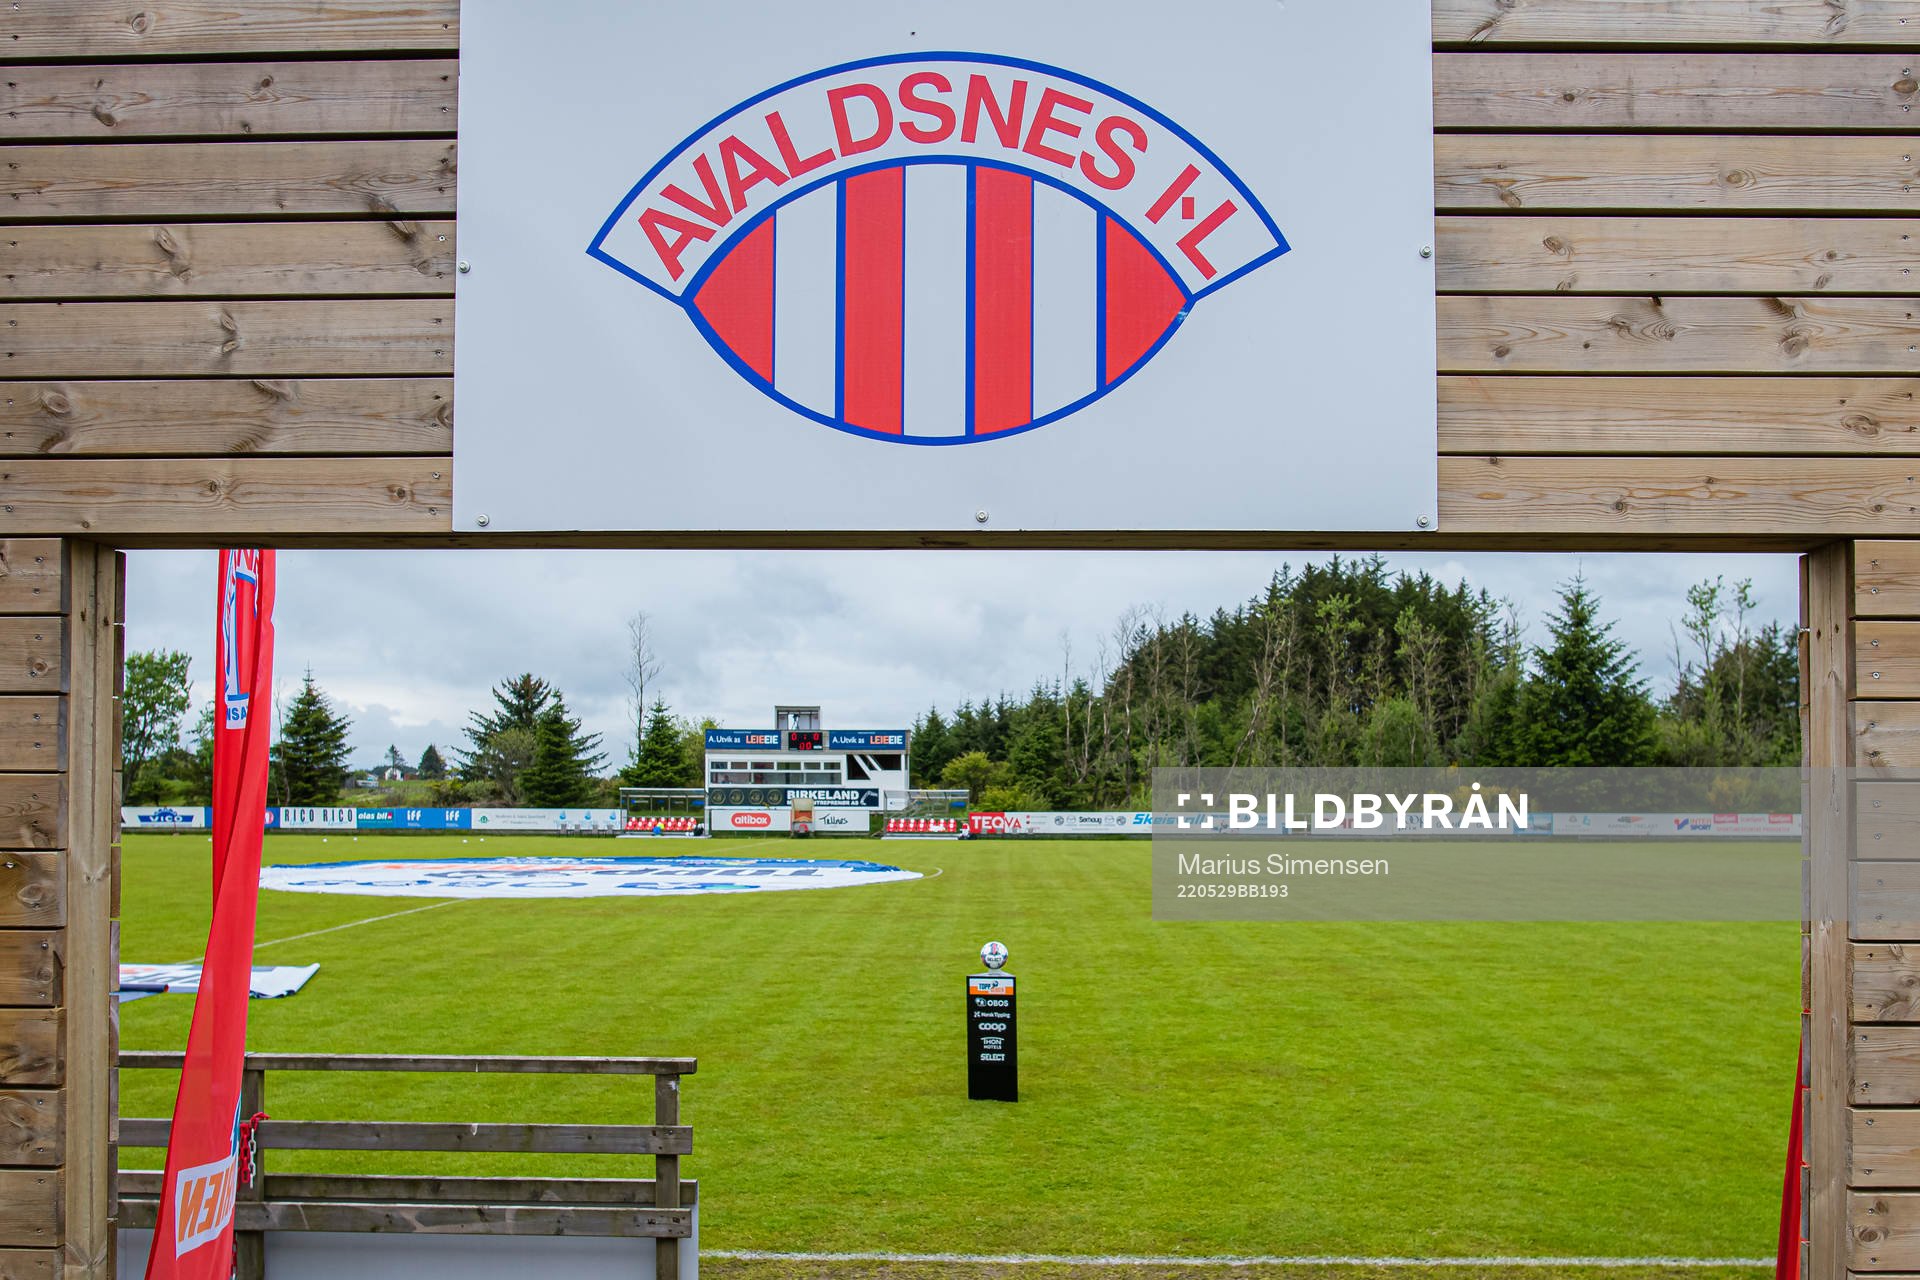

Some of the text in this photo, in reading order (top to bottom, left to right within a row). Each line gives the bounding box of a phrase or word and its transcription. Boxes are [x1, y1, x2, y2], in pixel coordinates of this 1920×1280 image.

[638, 72, 1148, 282] AVALDSNES
[787, 790, 859, 800] BIRKELAND
[978, 1023, 1006, 1032] coop
[980, 1053, 1005, 1061] SELECT
